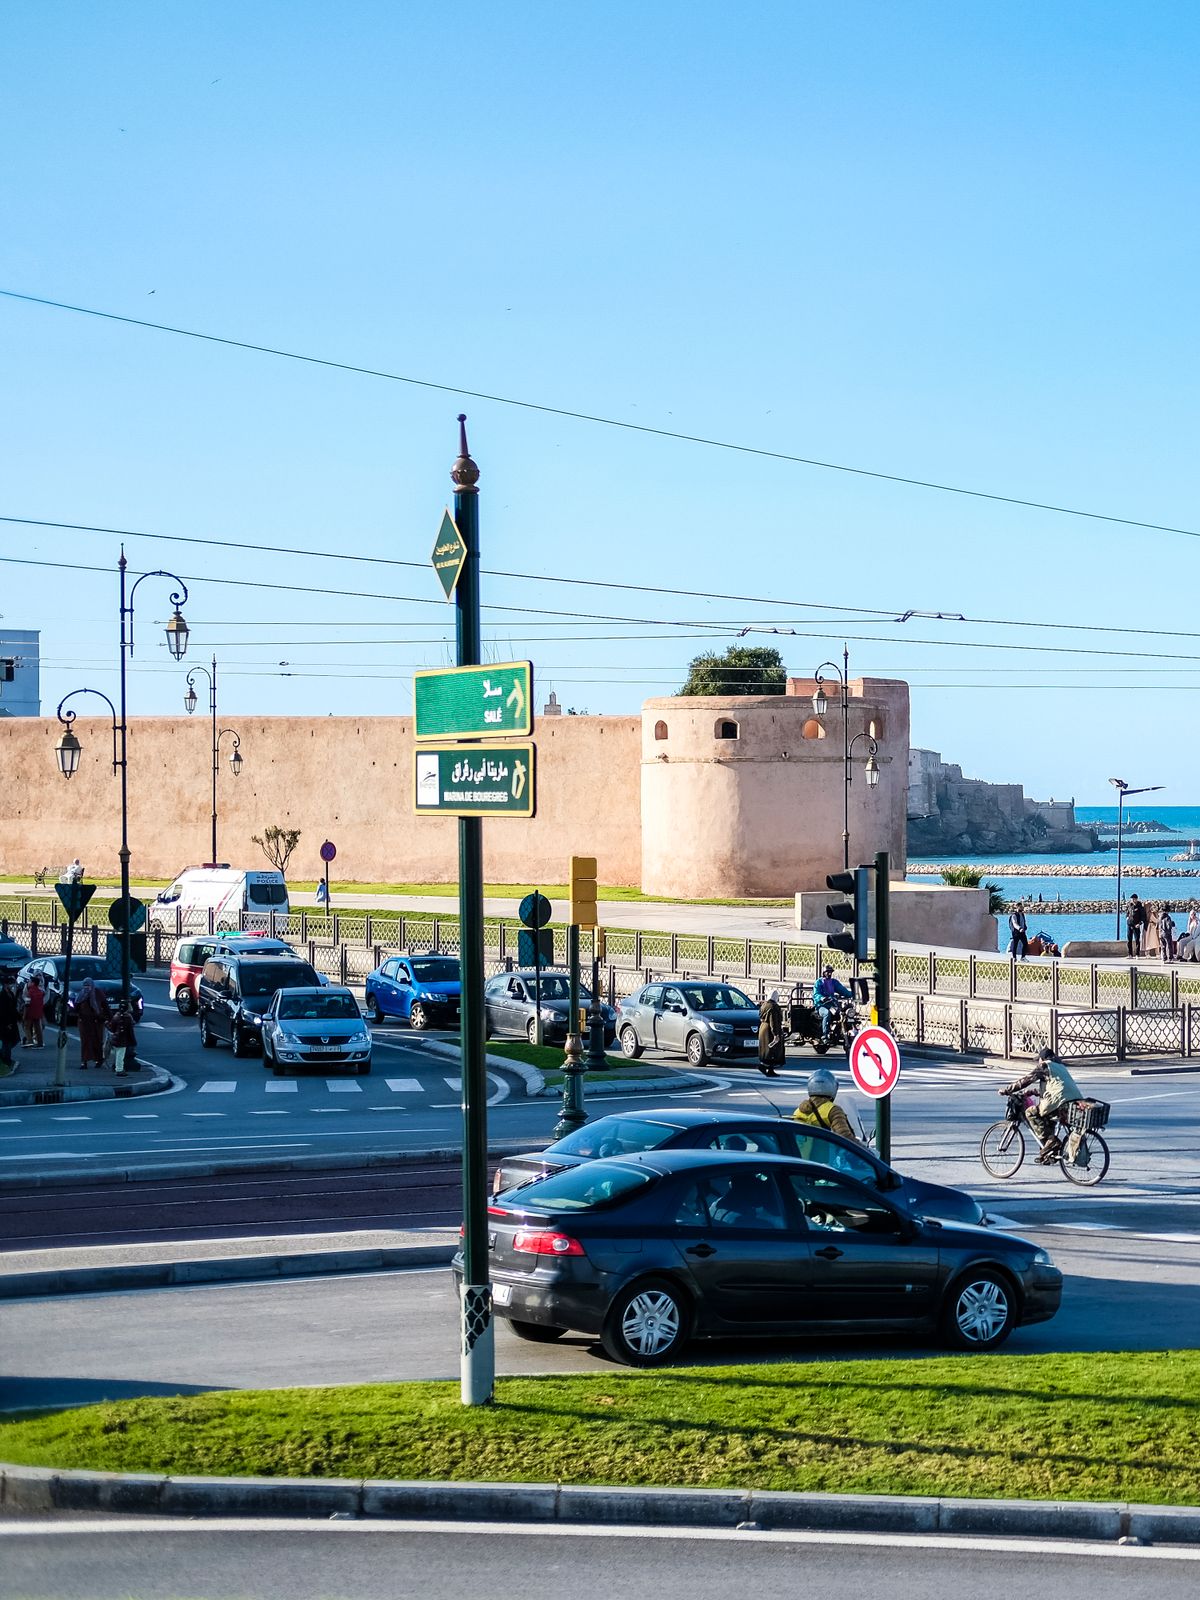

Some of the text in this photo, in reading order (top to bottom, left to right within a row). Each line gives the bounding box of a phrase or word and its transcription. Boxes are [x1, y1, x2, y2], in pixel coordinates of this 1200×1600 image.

[483, 679, 502, 698] سلا
[484, 707, 502, 723] SALÉ
[452, 758, 473, 783] رقراق
[487, 761, 508, 781] مارينا
[443, 792, 464, 802] MARINA
[465, 792, 473, 802] DE
